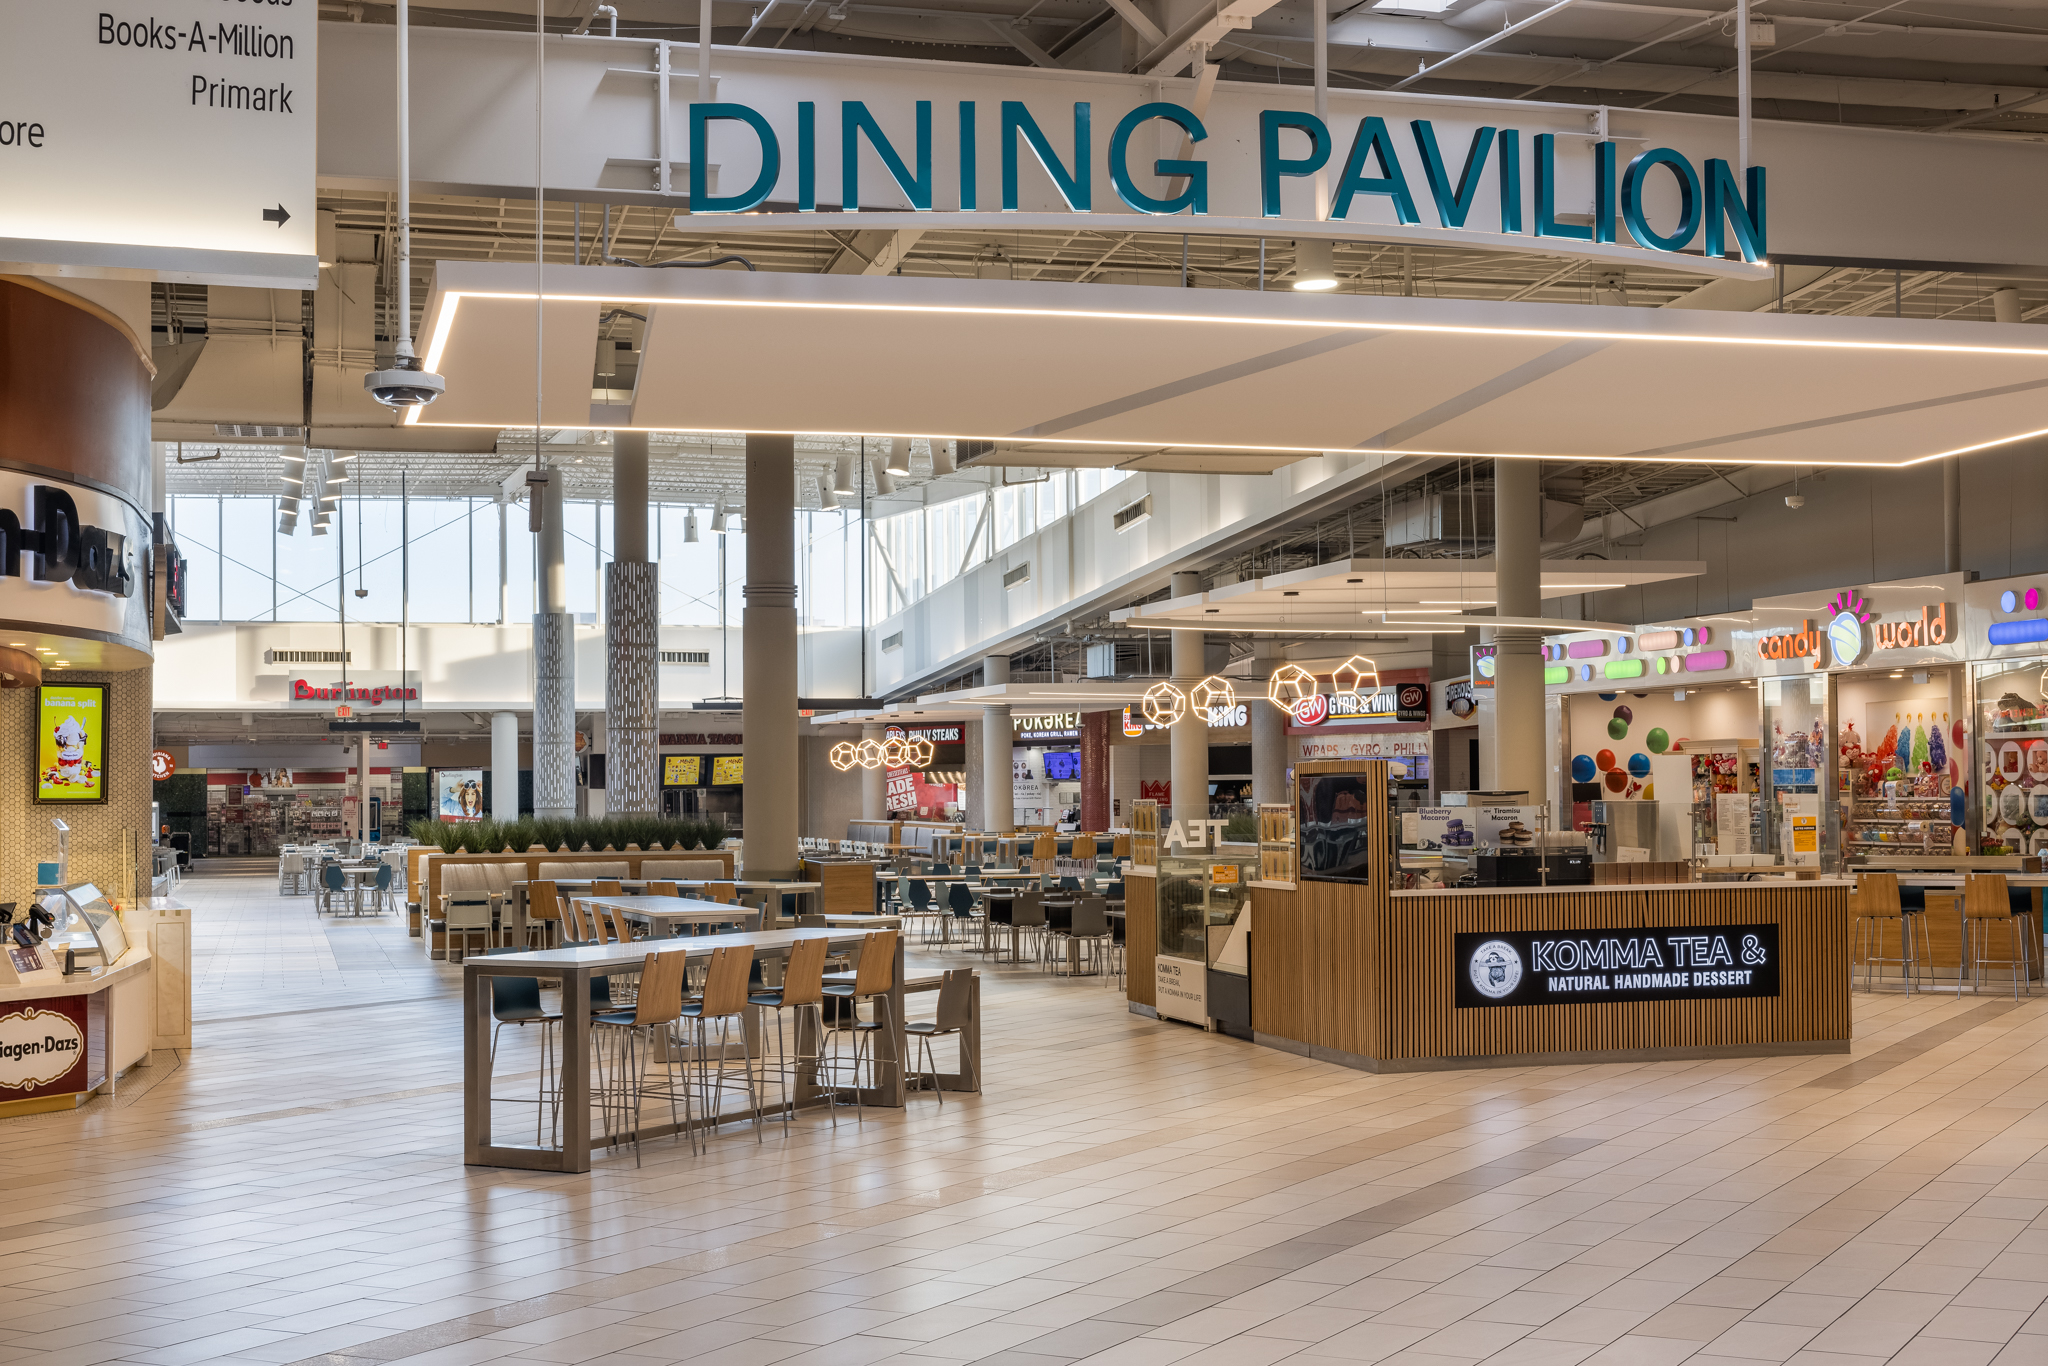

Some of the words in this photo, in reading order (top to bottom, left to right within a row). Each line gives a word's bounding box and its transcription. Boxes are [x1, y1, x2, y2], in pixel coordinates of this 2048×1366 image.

[98, 13, 294, 59] Books-A-Million
[192, 75, 293, 113] Primark
[690, 101, 1208, 215] DINING
[1259, 110, 1767, 266] PAVILION
[1758, 619, 1820, 669] candy
[1875, 602, 1946, 649] world
[294, 679, 418, 706] Burington
[1445, 681, 1471, 701] FIREHOUS
[45, 698, 76, 707] banana
[78, 699, 96, 709] split
[337, 706, 351, 717] EXIT
[1300, 699, 1322, 719] GW
[1329, 695, 1357, 714] GYRO
[1360, 695, 1370, 713] &
[1208, 705, 1247, 728] KING
[932, 728, 959, 741] STEAKS
[1303, 745, 1339, 757] WRAPS
[1351, 743, 1381, 755] GYRO
[887, 777, 915, 796] ADE
[1532, 938, 1664, 971] KOMMA
[1668, 936, 1733, 967] TEA
[1741, 934, 1766, 964] &
[1157, 963, 1172, 975] KOMMA
[1173, 965, 1181, 976] TEA
[1549, 975, 1610, 992] NATURAL
[1614, 973, 1689, 989] HANDMADE
[1693, 970, 1752, 987] DESSERT
